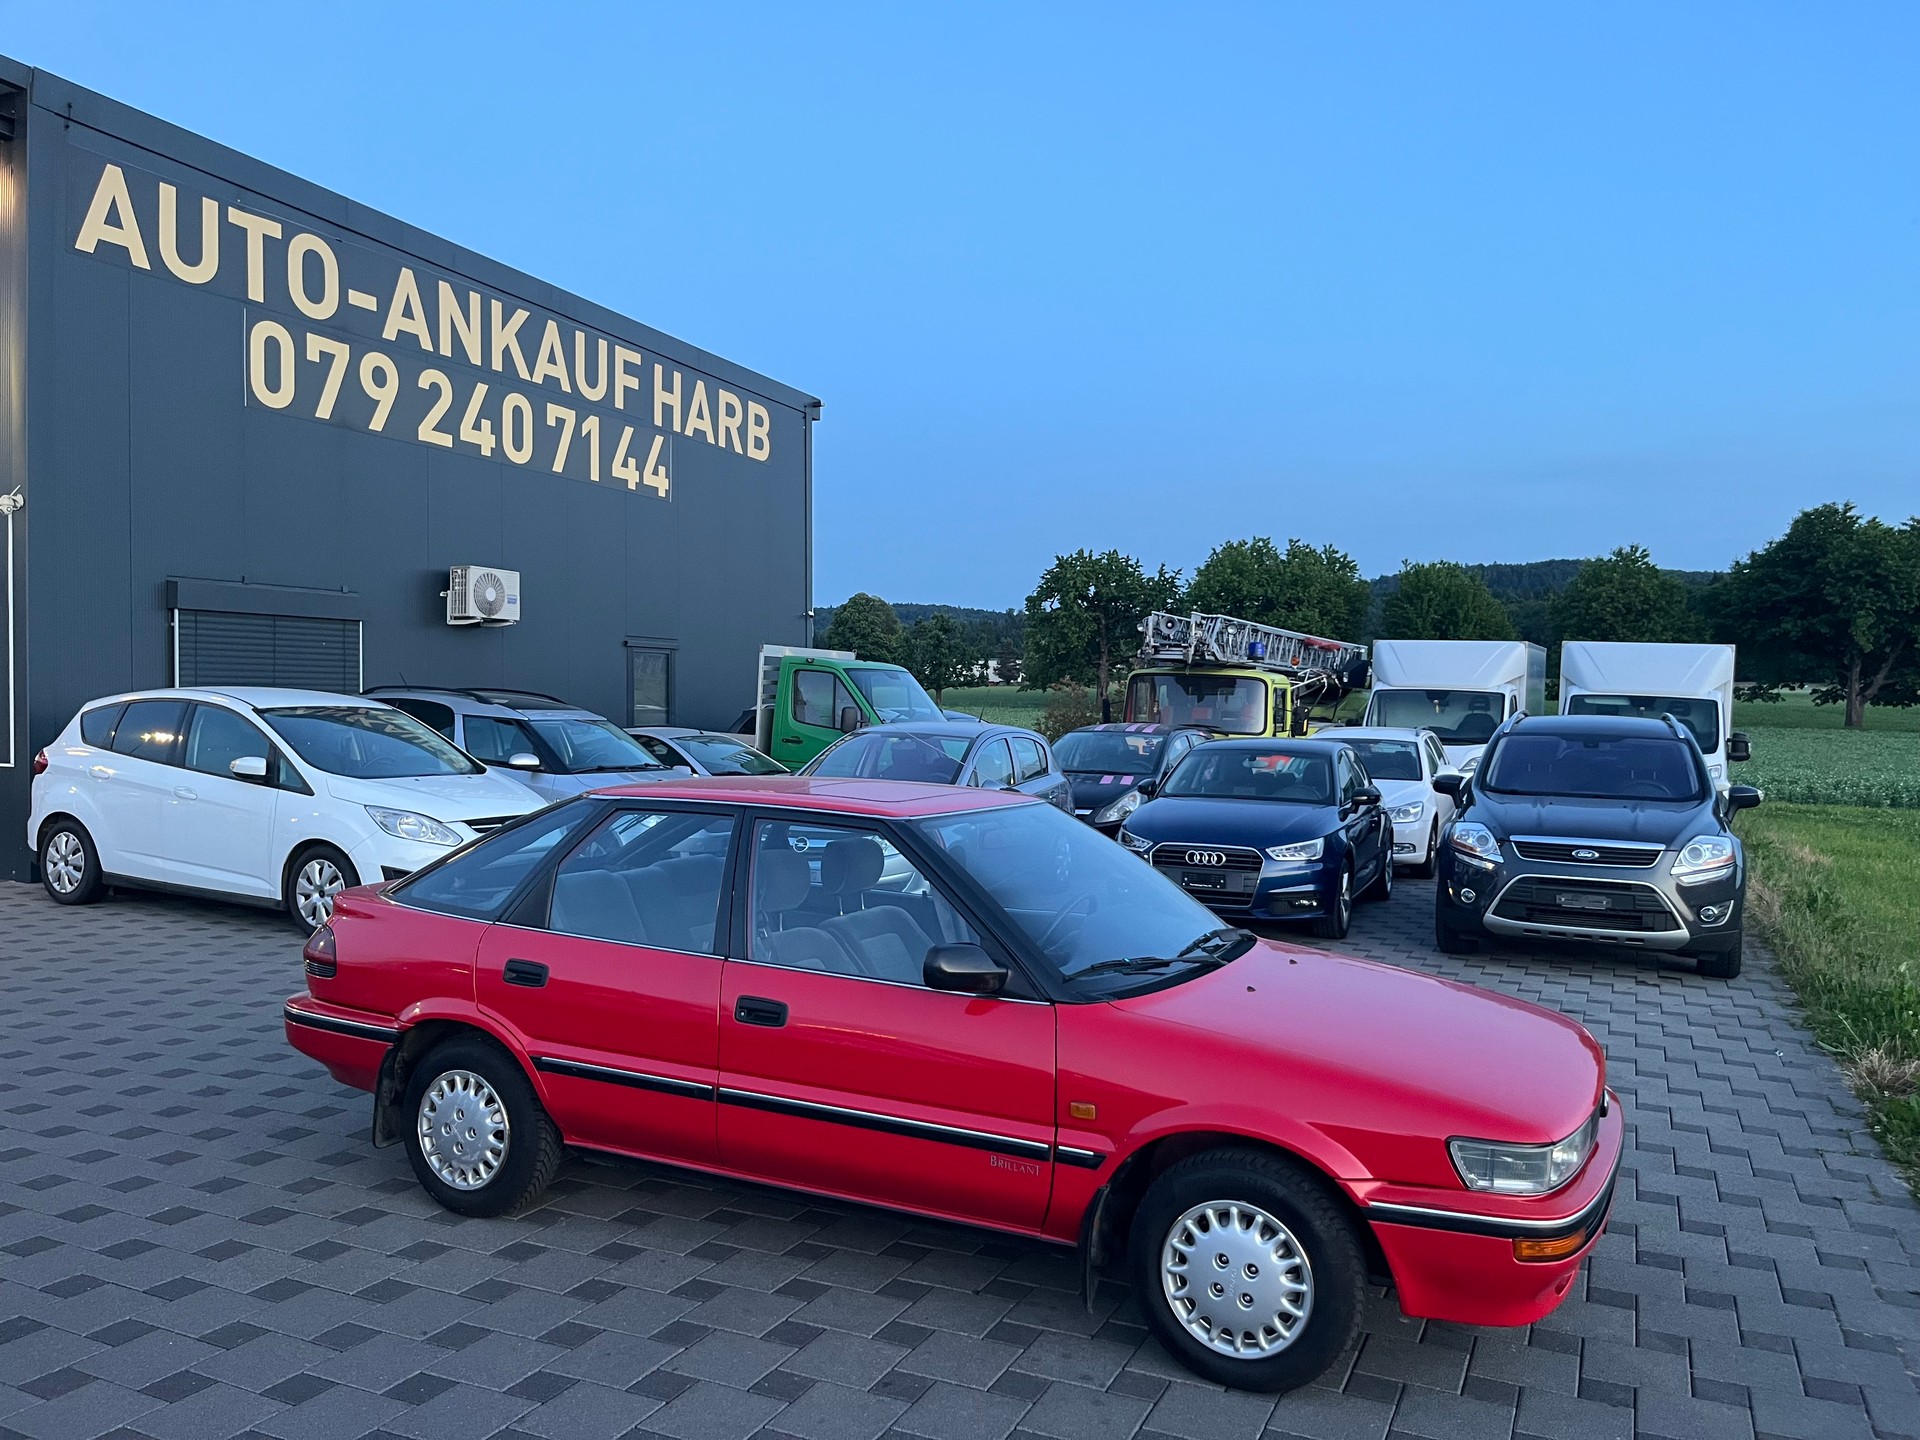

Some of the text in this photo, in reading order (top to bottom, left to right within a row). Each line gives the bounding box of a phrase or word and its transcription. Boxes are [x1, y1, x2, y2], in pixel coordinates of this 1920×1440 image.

[75, 164, 771, 461] AUTO-ANKAUF HARB
[250, 321, 399, 431] 079
[418, 369, 534, 464] 240
[990, 1155, 1041, 1176] BRILLANT
